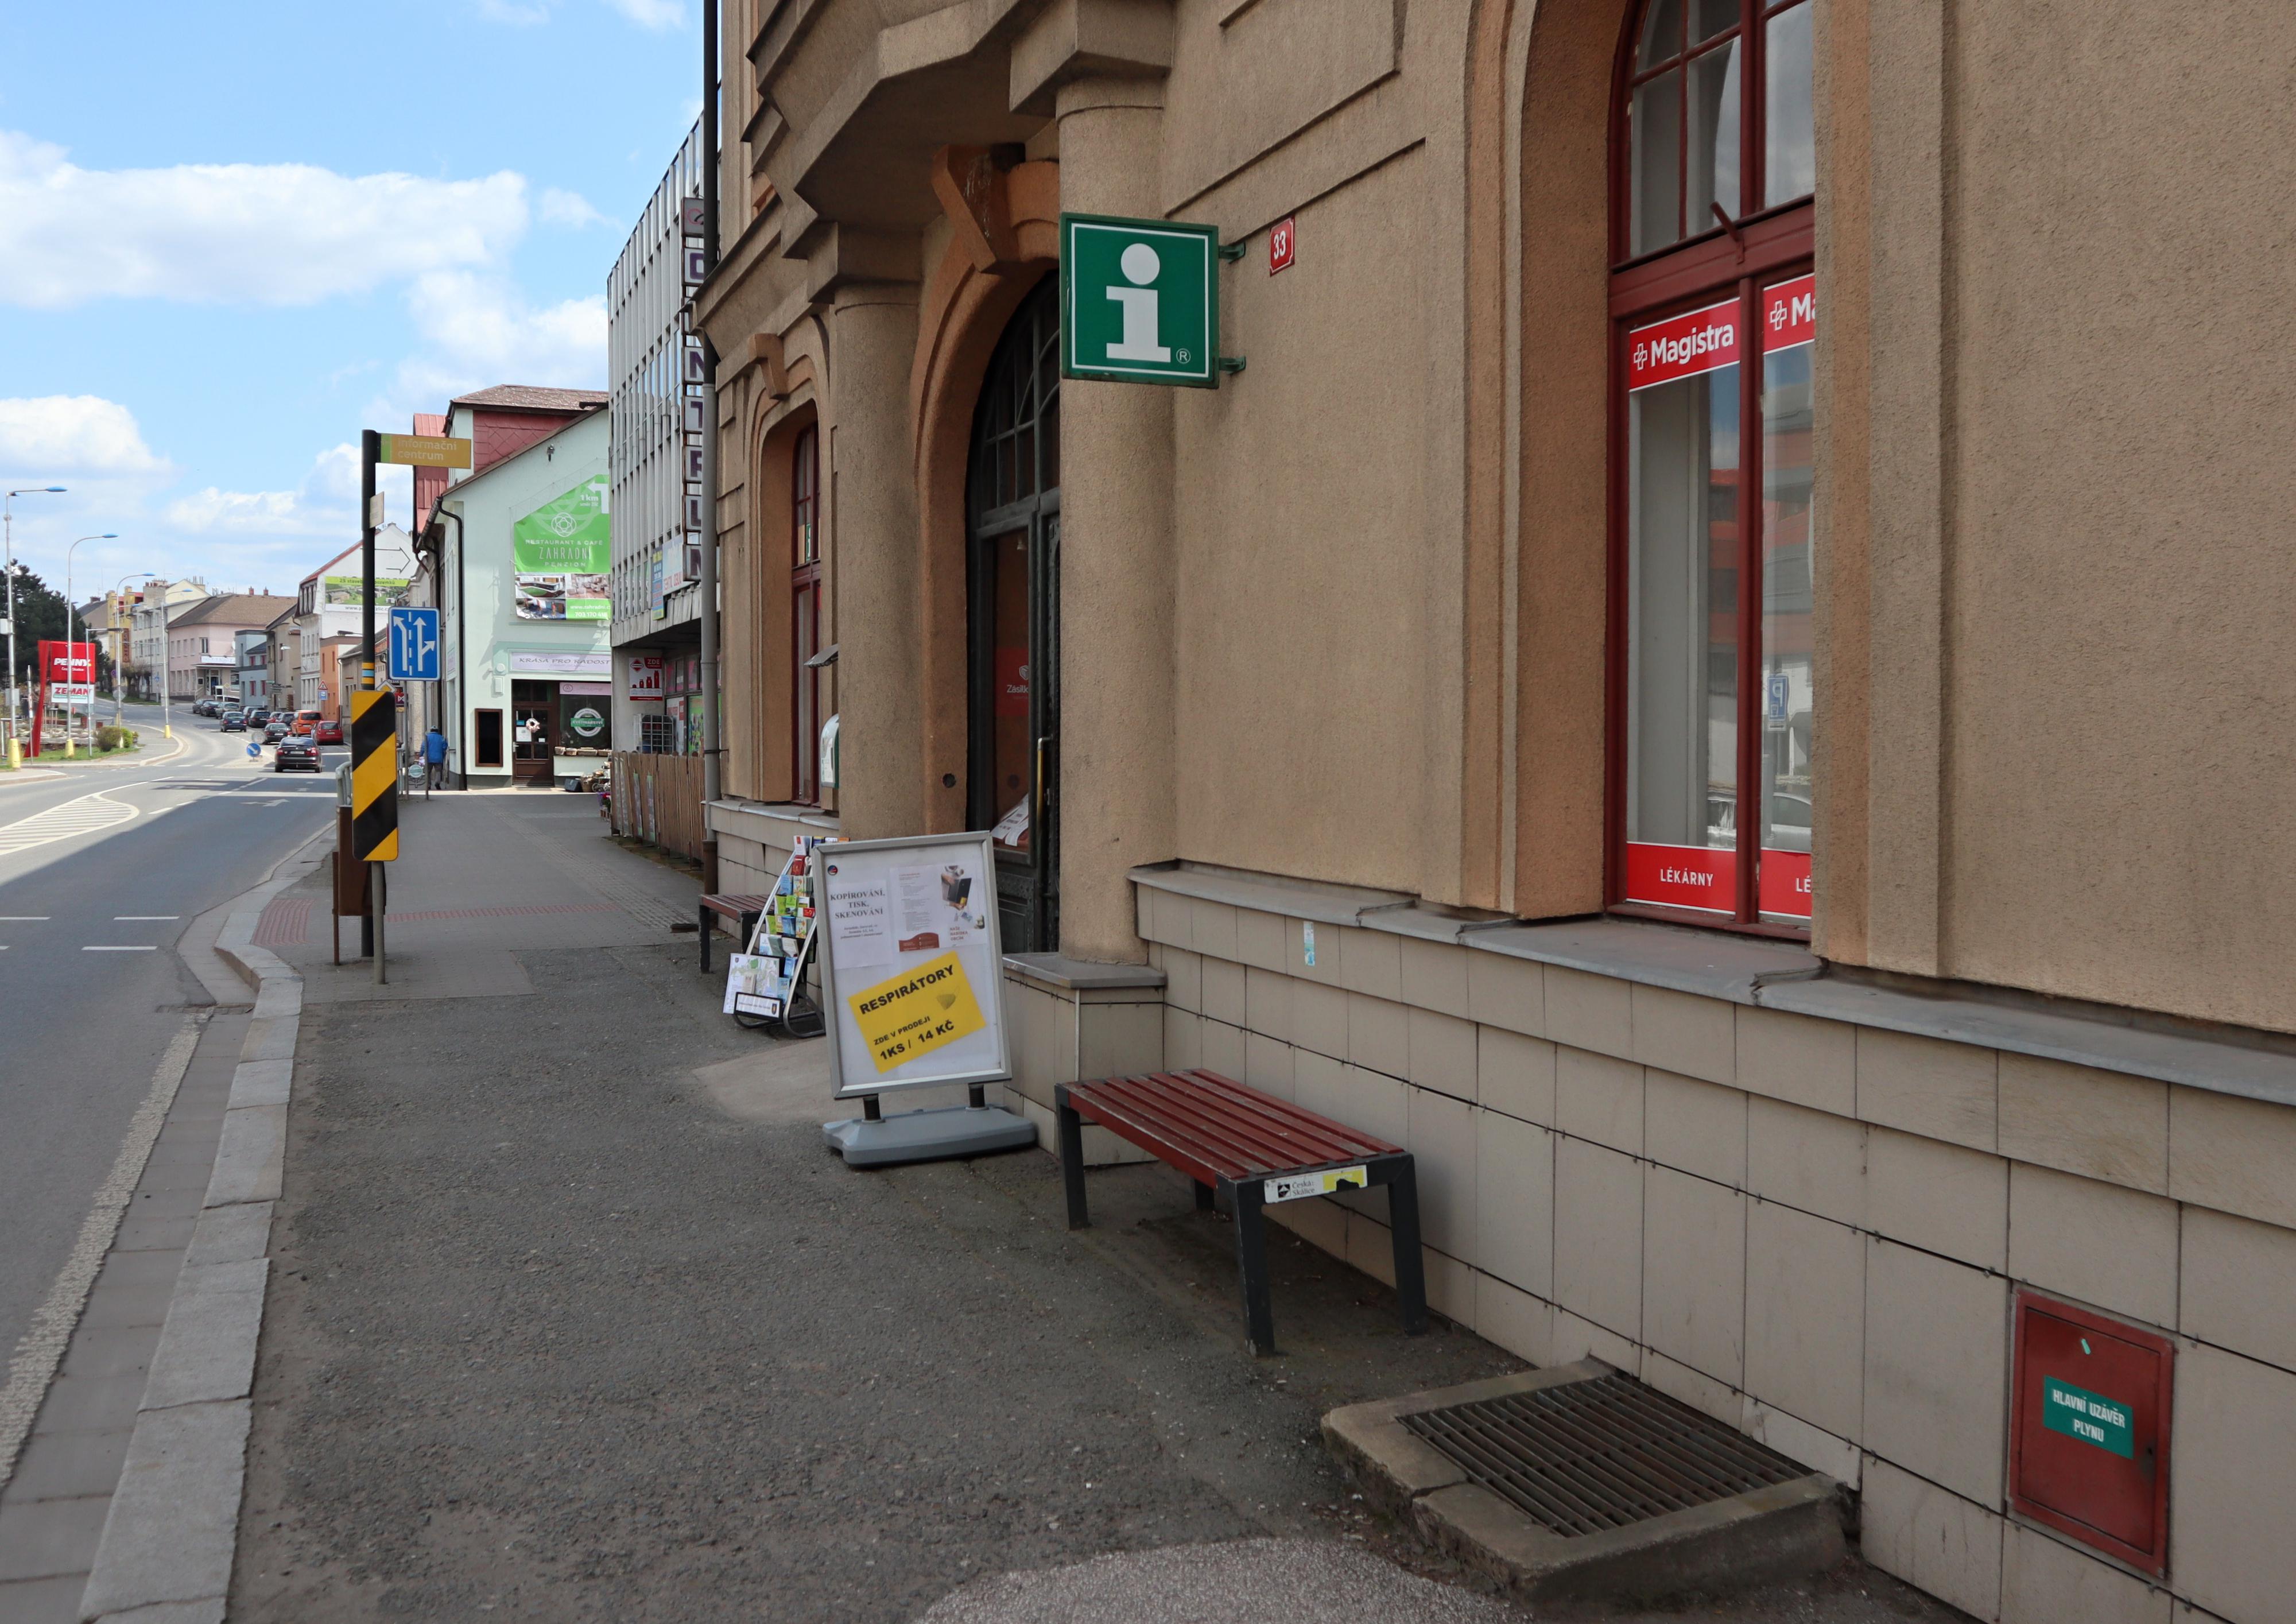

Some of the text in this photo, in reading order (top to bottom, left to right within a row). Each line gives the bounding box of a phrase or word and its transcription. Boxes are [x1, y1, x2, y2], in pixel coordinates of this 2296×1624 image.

[1273, 230, 1286, 259] 33
[1651, 324, 1733, 367] Magistra
[398, 451, 444, 460] centrum
[54, 658, 91, 666] PENNY
[55, 687, 91, 695] ZEMAN
[1660, 866, 1714, 887] LÉKÁRNY
[835, 906, 883, 919] SKENOVÁNÍ
[859, 964, 953, 1015] RESPIRÁTORY
[873, 1034, 890, 1046] ZDE
[897, 1016, 931, 1034] PRODEJI
[880, 1043, 905, 1060] 1KS
[918, 1030, 934, 1043] 14
[935, 1020, 955, 1036] KČ
[2052, 1389, 2126, 1428] HLAVNÍ UZÁVĚR
[2073, 1418, 2105, 1443] PLYNU
